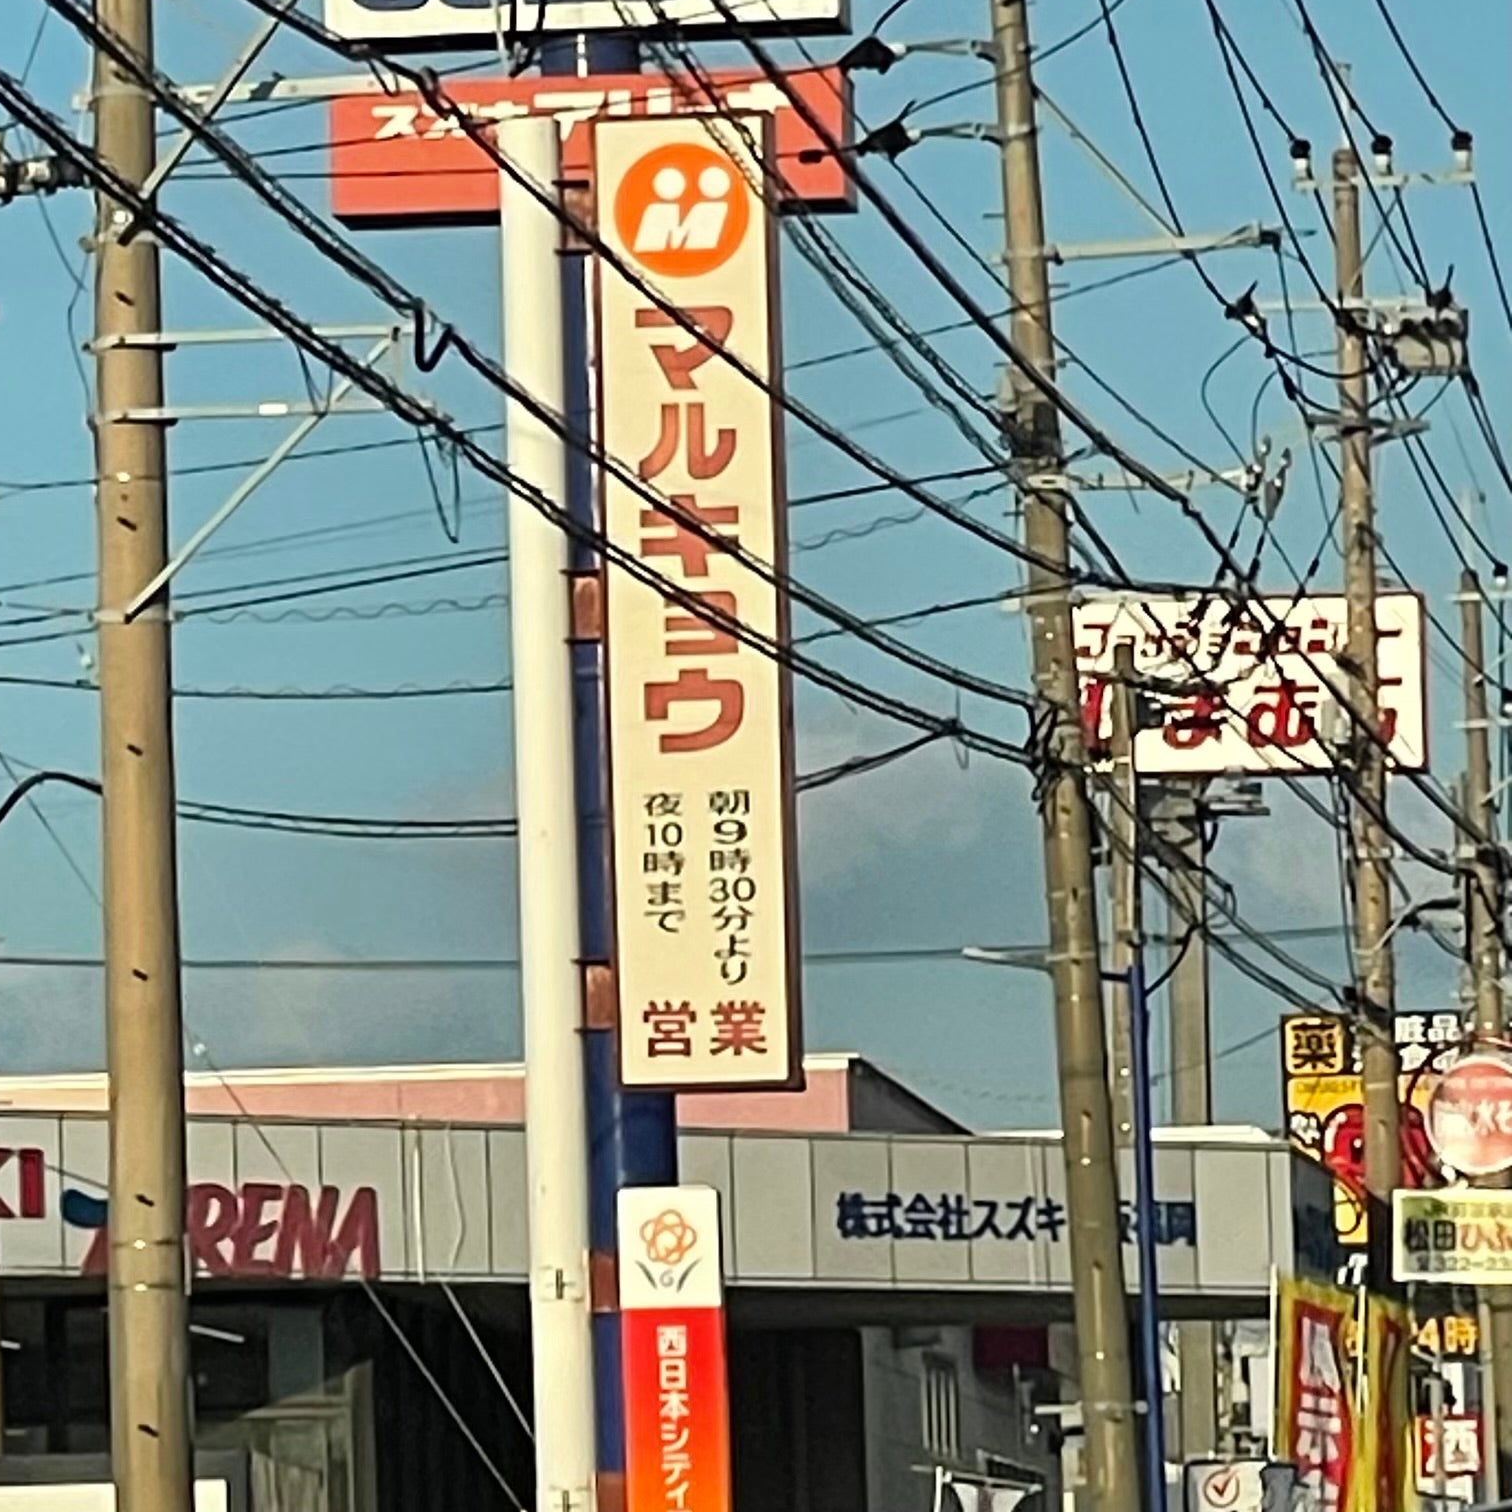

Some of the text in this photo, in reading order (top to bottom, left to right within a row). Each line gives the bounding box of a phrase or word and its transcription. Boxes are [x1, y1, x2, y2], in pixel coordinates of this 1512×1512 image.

[634, 306, 745, 754] マルキョウ
[642, 792, 686, 934] 夜10時まで
[708, 790, 756, 986] 朝9時30分より
[642, 999, 768, 1059] 営業
[80, 1182, 382, 1281] RENA
[656, 1324, 692, 1512] 西日本シティ
